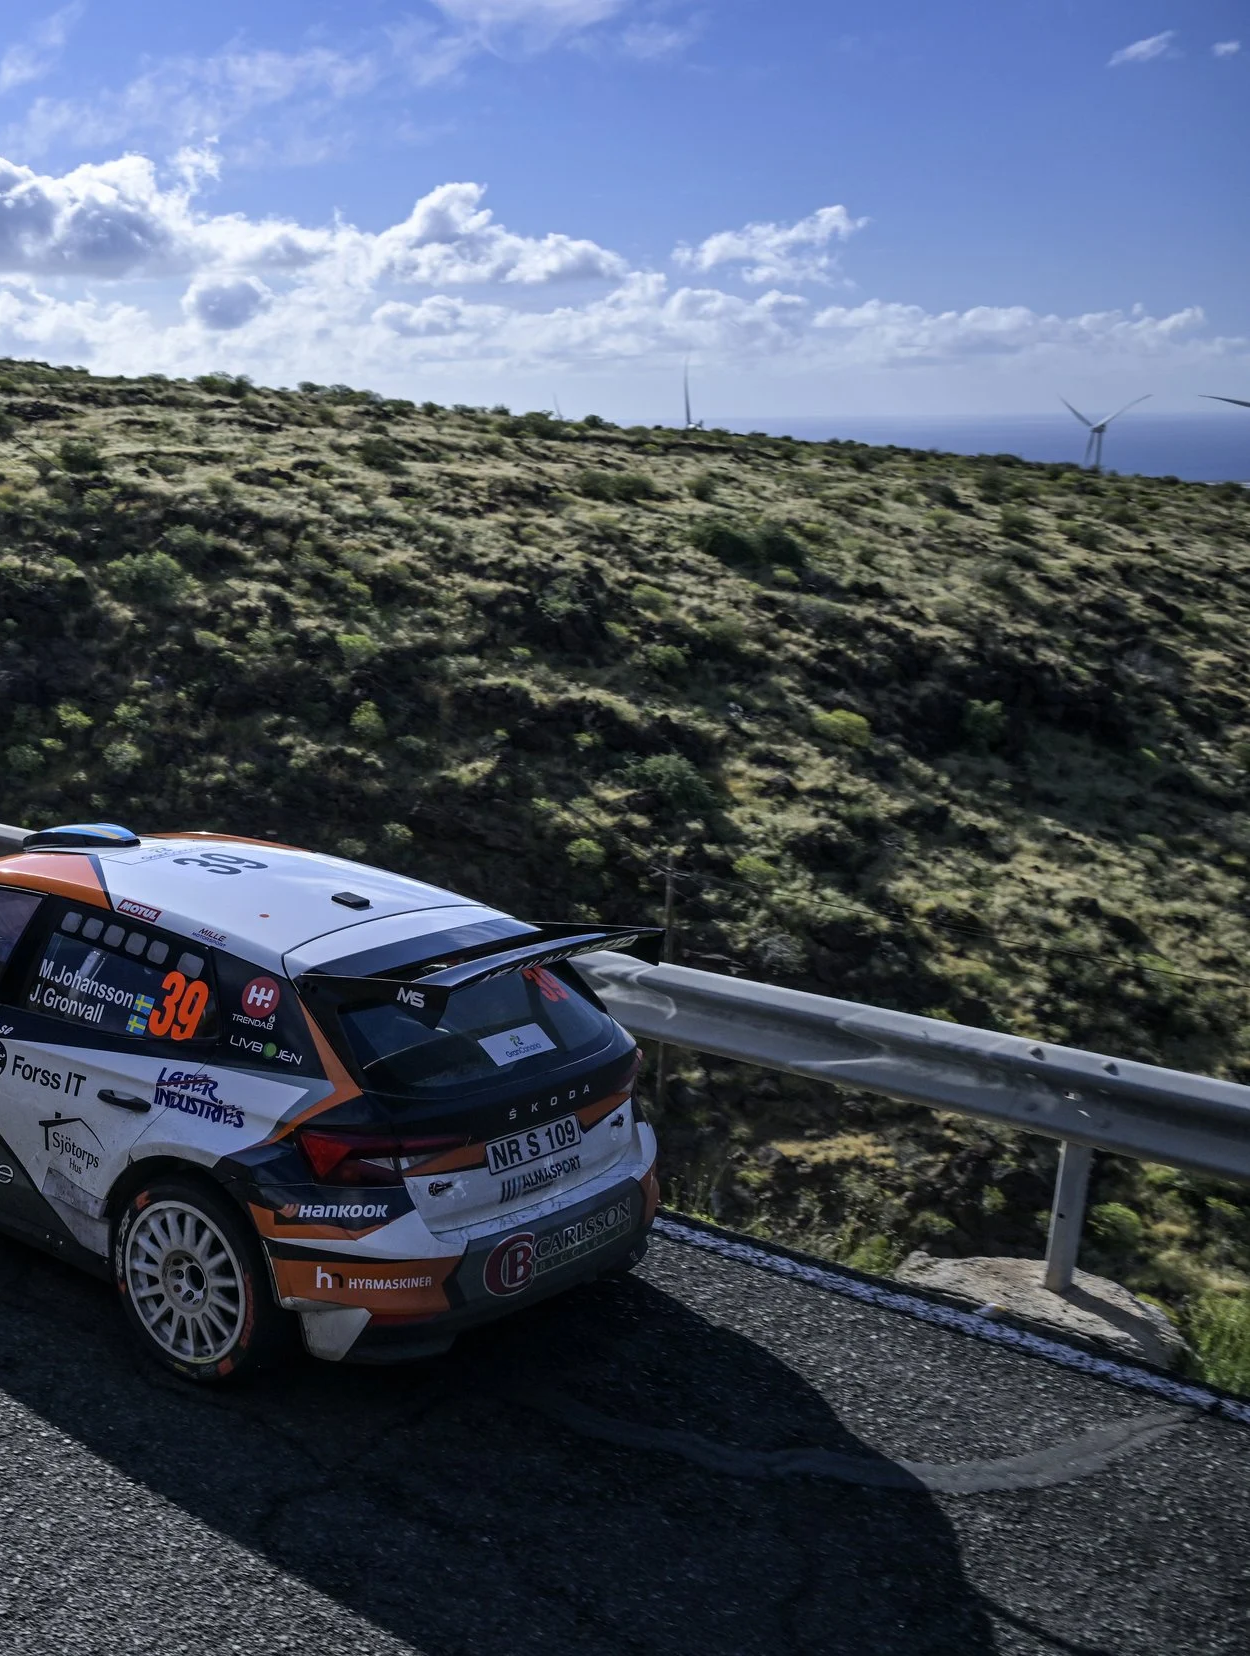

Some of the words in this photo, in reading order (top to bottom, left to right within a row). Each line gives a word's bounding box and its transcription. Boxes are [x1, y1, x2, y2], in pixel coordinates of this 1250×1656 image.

[173, 853, 269, 876] 39
[119, 902, 158, 920] MOTUL
[192, 932, 227, 948] MOTORSPORT
[199, 928, 227, 942] MILLE
[38, 959, 134, 1008] M.Johansson
[396, 987, 426, 1009] MS
[148, 970, 210, 1041] 39
[11, 1055, 62, 1090] Forss
[64, 1072, 87, 1096] IT
[508, 1084, 590, 1120] ŠKODA
[52, 1131, 100, 1169] Sjötorps
[491, 1141, 523, 1170] NR
[526, 1132, 541, 1156] S
[545, 1119, 576, 1150] 109
[69, 1158, 82, 1175] Hus
[522, 1156, 581, 1188] ALMASPORT
[534, 1197, 631, 1259] CARLSSON
[348, 1276, 432, 1290] HYRMASKINER
